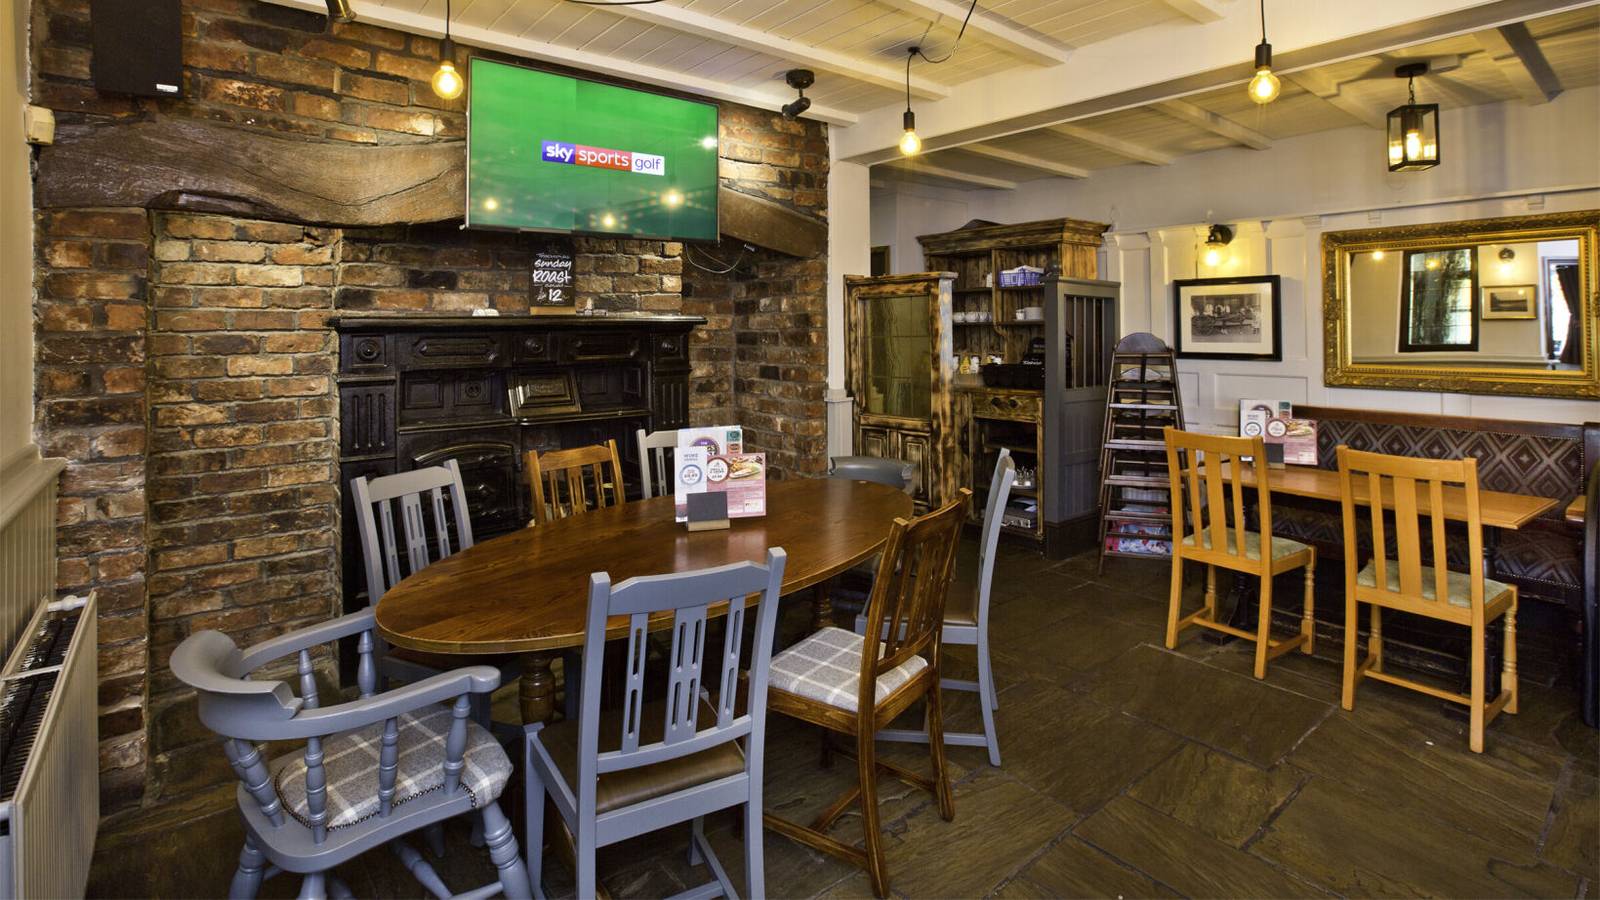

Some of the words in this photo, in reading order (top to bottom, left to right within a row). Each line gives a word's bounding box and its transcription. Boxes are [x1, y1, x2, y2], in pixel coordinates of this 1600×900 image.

[545, 143, 574, 162] sky
[578, 149, 630, 167] sports
[635, 157, 662, 171] golf
[548, 288, 563, 302] 12
